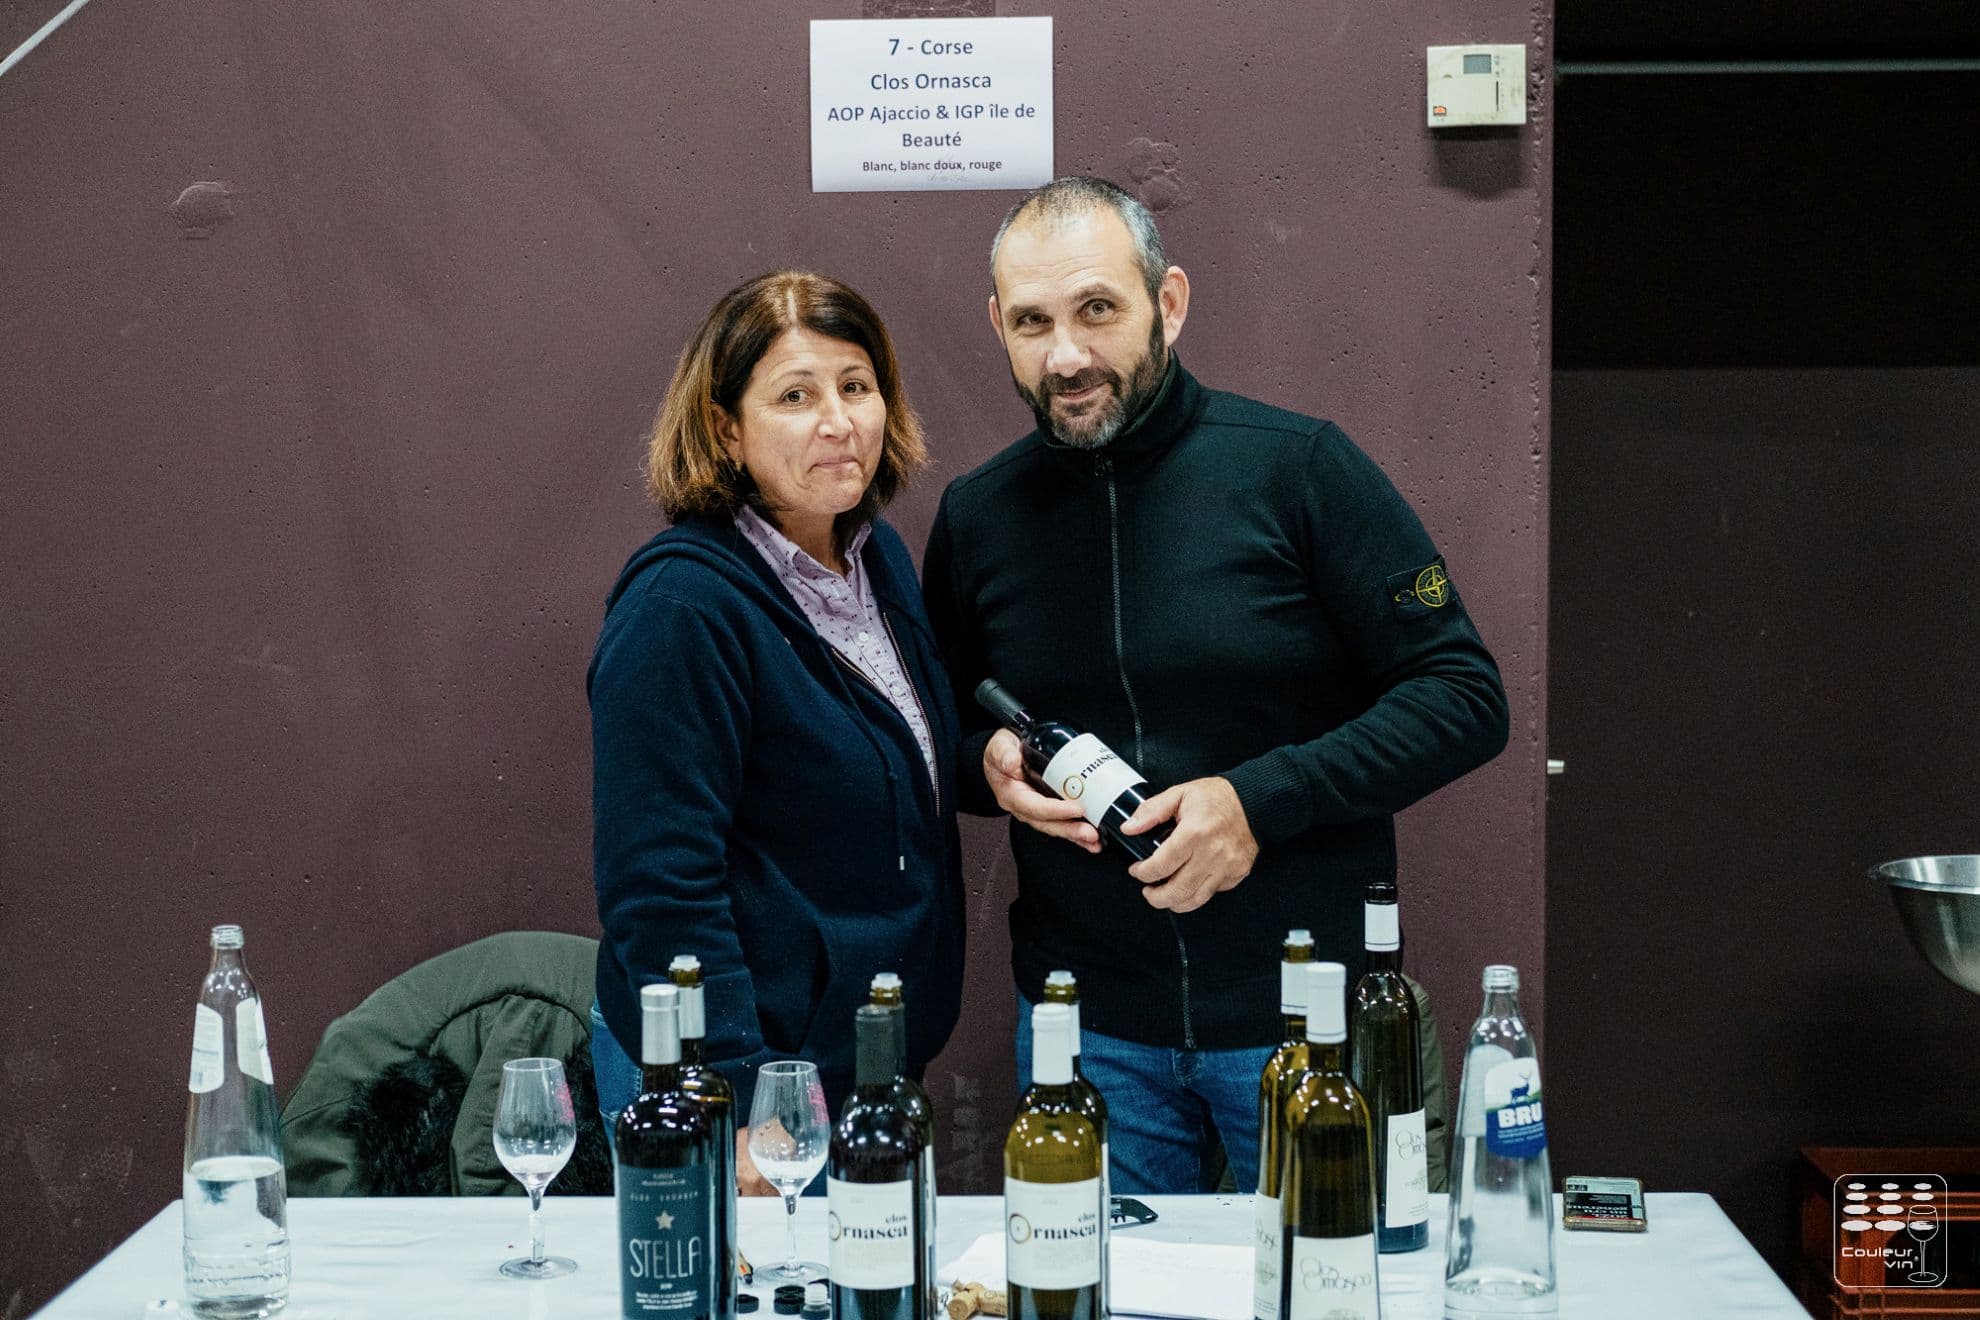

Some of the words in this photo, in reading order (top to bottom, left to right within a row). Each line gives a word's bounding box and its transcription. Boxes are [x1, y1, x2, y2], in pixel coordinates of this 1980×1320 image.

[888, 38, 900, 56] 7
[920, 39, 973, 55] Corse
[871, 73, 909, 90] Clos
[915, 73, 992, 89] Ornasca
[827, 107, 864, 121] AOP
[870, 106, 930, 124] Ajaccio
[936, 105, 949, 120] &
[955, 105, 984, 119] IGP
[989, 104, 1009, 118] île
[1015, 103, 1035, 118] de
[902, 131, 962, 147] Beauté
[863, 160, 897, 173] Blanc,
[900, 160, 930, 171] blanc
[934, 159, 966, 171] doux,
[969, 160, 1002, 173] rouge
[1497, 1101, 1542, 1128] BRU
[885, 1213, 907, 1224] clos
[1009, 1212, 1096, 1244] Ornasca
[629, 1236, 702, 1279] STELLA
